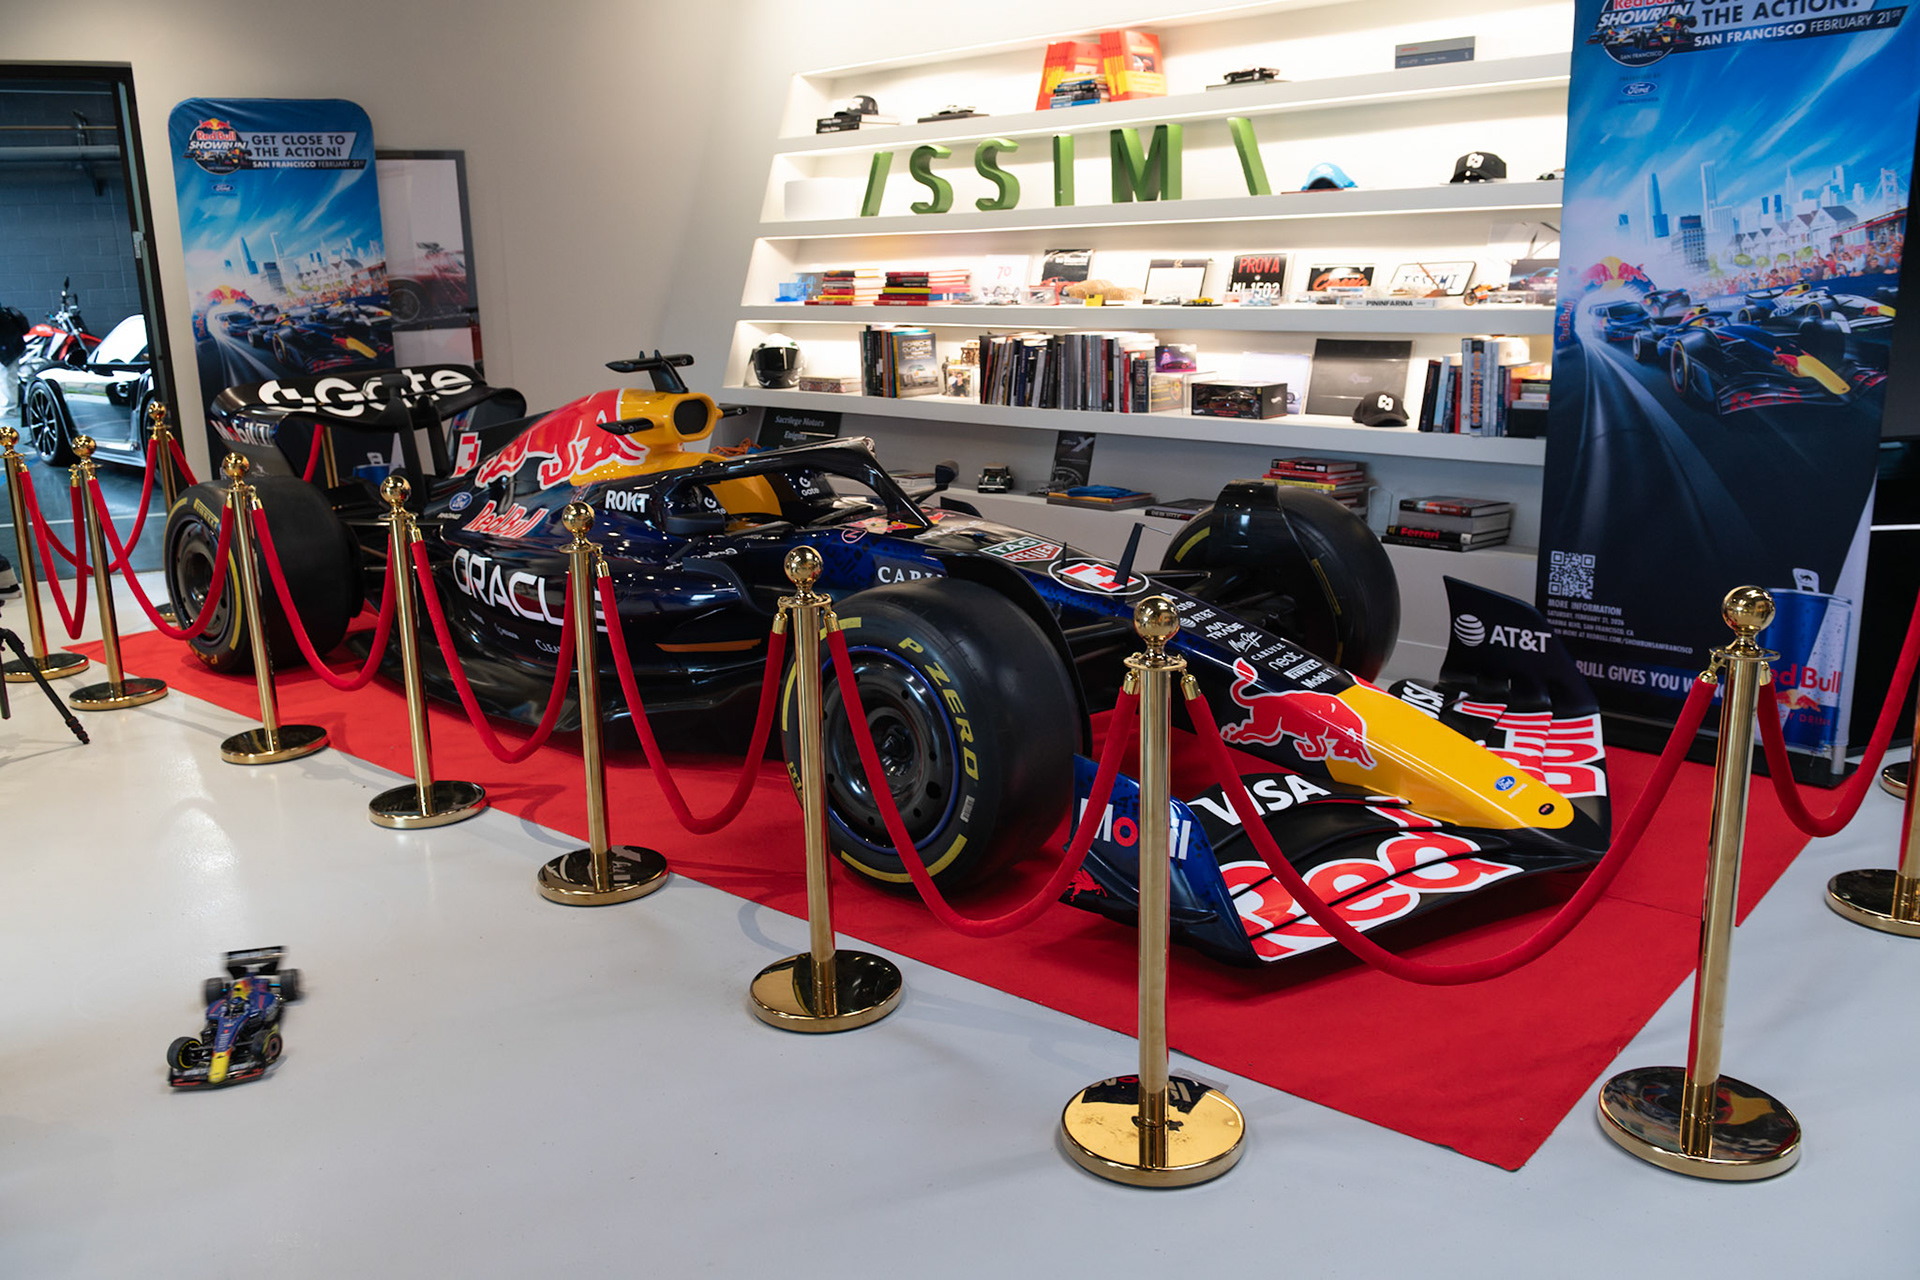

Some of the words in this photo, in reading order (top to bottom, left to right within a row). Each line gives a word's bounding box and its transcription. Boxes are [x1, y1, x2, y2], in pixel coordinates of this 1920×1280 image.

[1702, 6, 1743, 26] THE
[1694, 34, 1722, 47] SAN
[1726, 24, 1805, 43] FRANCISCO
[1810, 14, 1873, 33] FEBRUARY
[1627, 83, 1651, 95] Ford
[196, 131, 216, 141] Red
[217, 131, 236, 141] Bull
[252, 135, 276, 145] GET
[282, 135, 323, 146] CLOSE
[327, 135, 346, 144] TO
[255, 147, 279, 157] THE
[285, 147, 342, 157] ACTION!
[860, 117, 1271, 217] ISSIMI
[1238, 256, 1280, 275] PROVA
[1250, 282, 1280, 300] 1502
[1366, 299, 1413, 307] PININFARINA
[775, 415, 802, 427] Sacrilege
[803, 417, 825, 427] Motors
[210, 419, 257, 446] Mobil
[605, 490, 650, 513] ROKT
[1401, 527, 1440, 540] Ferrari
[991, 539, 1038, 554] TAG
[1007, 544, 1056, 561] HEUER
[877, 567, 948, 584] CAR
[453, 548, 608, 633] ORACL
[1177, 600, 1197, 612] ate
[1547, 599, 1569, 609] MORE
[1571, 601, 1622, 616] INFORMATION
[1190, 609, 1217, 623] AT&T
[1206, 622, 1244, 640] TRADE
[1489, 625, 1551, 653] AT&T
[535, 638, 561, 654] CLEA
[1251, 643, 1286, 661] CARLYLE
[1283, 659, 1323, 680] PIRELLI
[1608, 665, 1646, 685] GIVES
[1650, 671, 1680, 691] YOU
[1770, 663, 1797, 686] ed
[1800, 666, 1842, 693] Bull
[1301, 671, 1328, 689] Mobil
[898, 637, 924, 654] P
[924, 661, 979, 781] ZERO
[1186, 775, 1331, 826] VISA
[1079, 797, 1192, 861] Moil
[1218, 797, 1525, 963] Red
